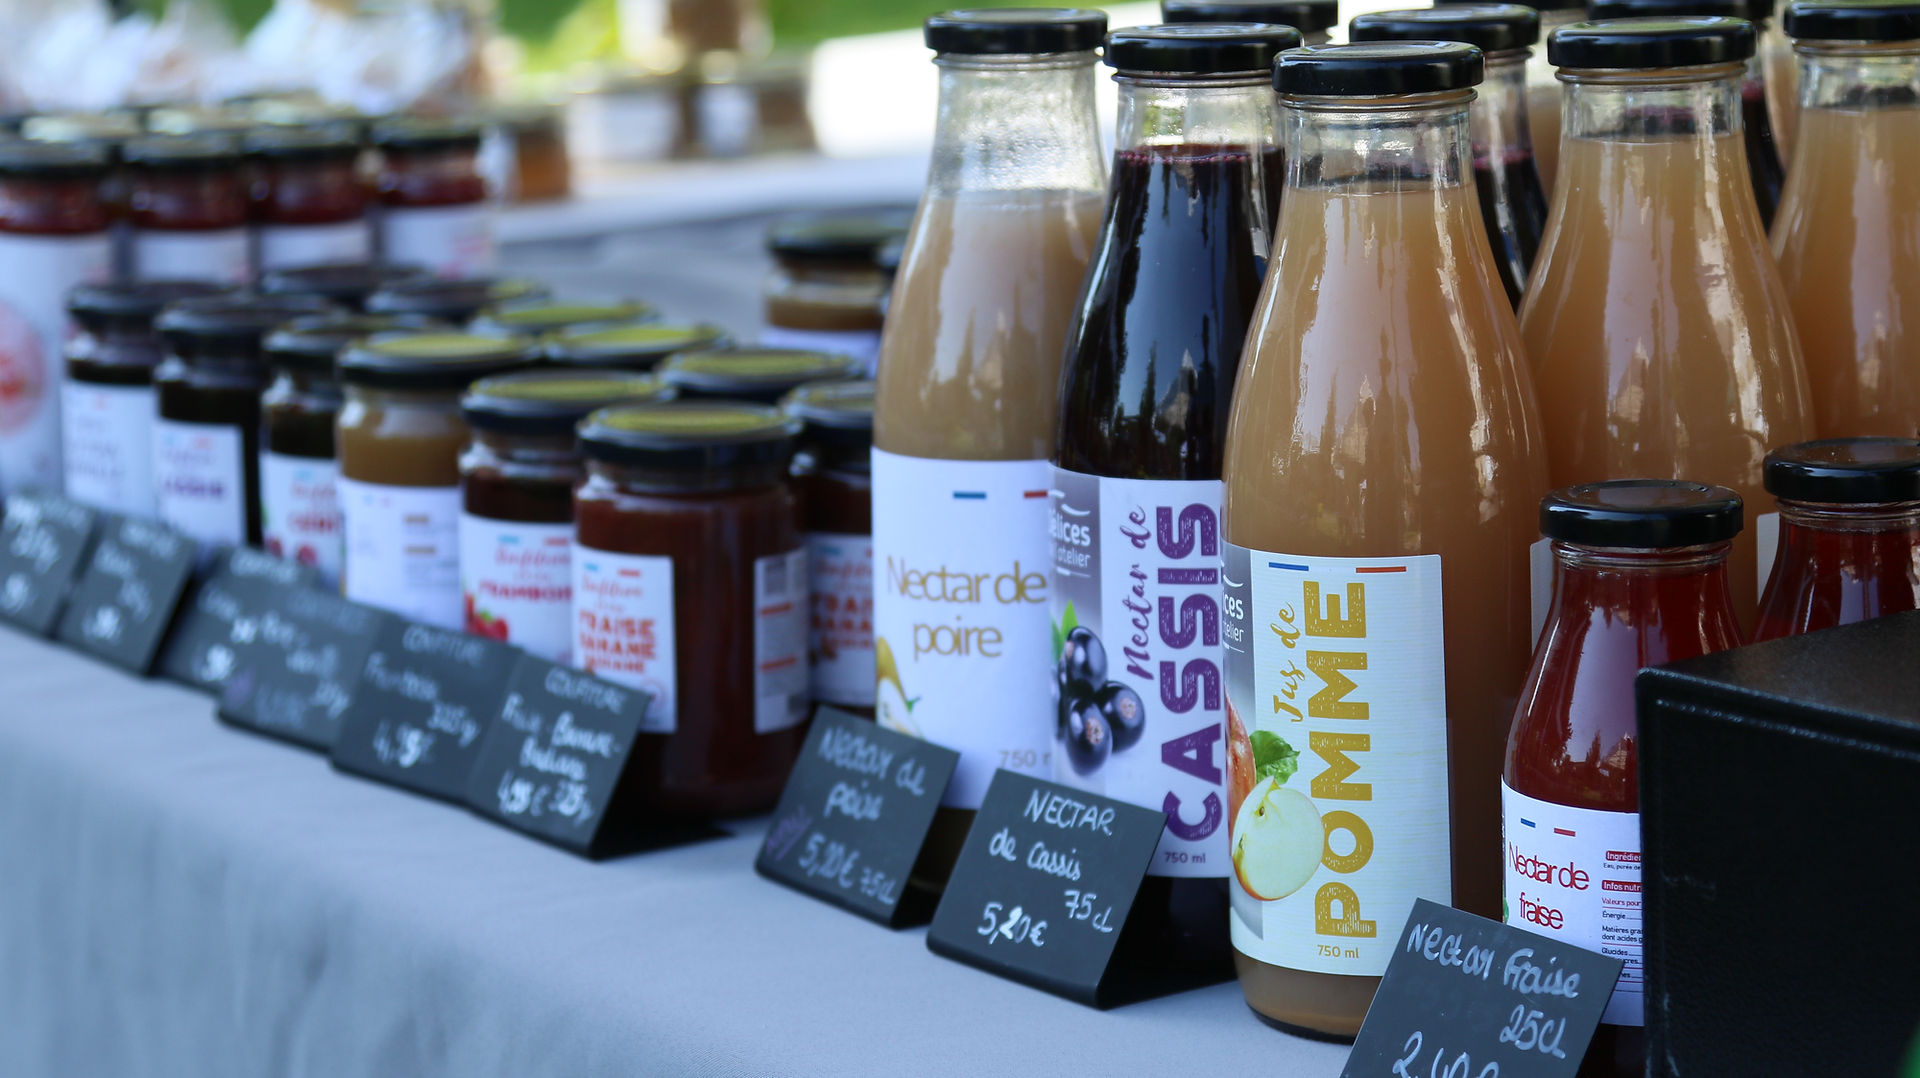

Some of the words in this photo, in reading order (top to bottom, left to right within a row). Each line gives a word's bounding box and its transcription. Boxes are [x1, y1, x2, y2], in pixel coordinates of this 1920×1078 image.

[1120, 505, 1152, 550] de
[887, 555, 990, 605] Nectar
[994, 560, 1048, 605] de
[913, 615, 1004, 661] poire
[1123, 564, 1155, 680] Nectar
[1270, 602, 1303, 648] de
[1156, 503, 1223, 842] CASSIS
[1273, 659, 1305, 722] Jus
[895, 757, 926, 796] de
[1304, 580, 1377, 938] POMME
[1023, 788, 1116, 836] NECTAR
[989, 827, 1017, 861] de
[1165, 852, 1188, 864] 750
[1192, 853, 1206, 864] ml
[1508, 841, 1557, 885] Nectar
[1558, 861, 1590, 891] de
[1601, 897, 1625, 906] Valeurs
[1603, 881, 1623, 890] Infos
[1624, 884, 1641, 892] nutr
[977, 901, 1049, 947] 5,20€
[1519, 891, 1564, 930] fraise
[1602, 910, 1625, 920] Énergie
[1602, 924, 1629, 934] Matières
[1317, 945, 1341, 958] 750
[1344, 946, 1360, 959] ml
[1407, 923, 1495, 981] Nectar
[1503, 948, 1579, 998] Fraise
[1602, 947, 1628, 956] Glucides
